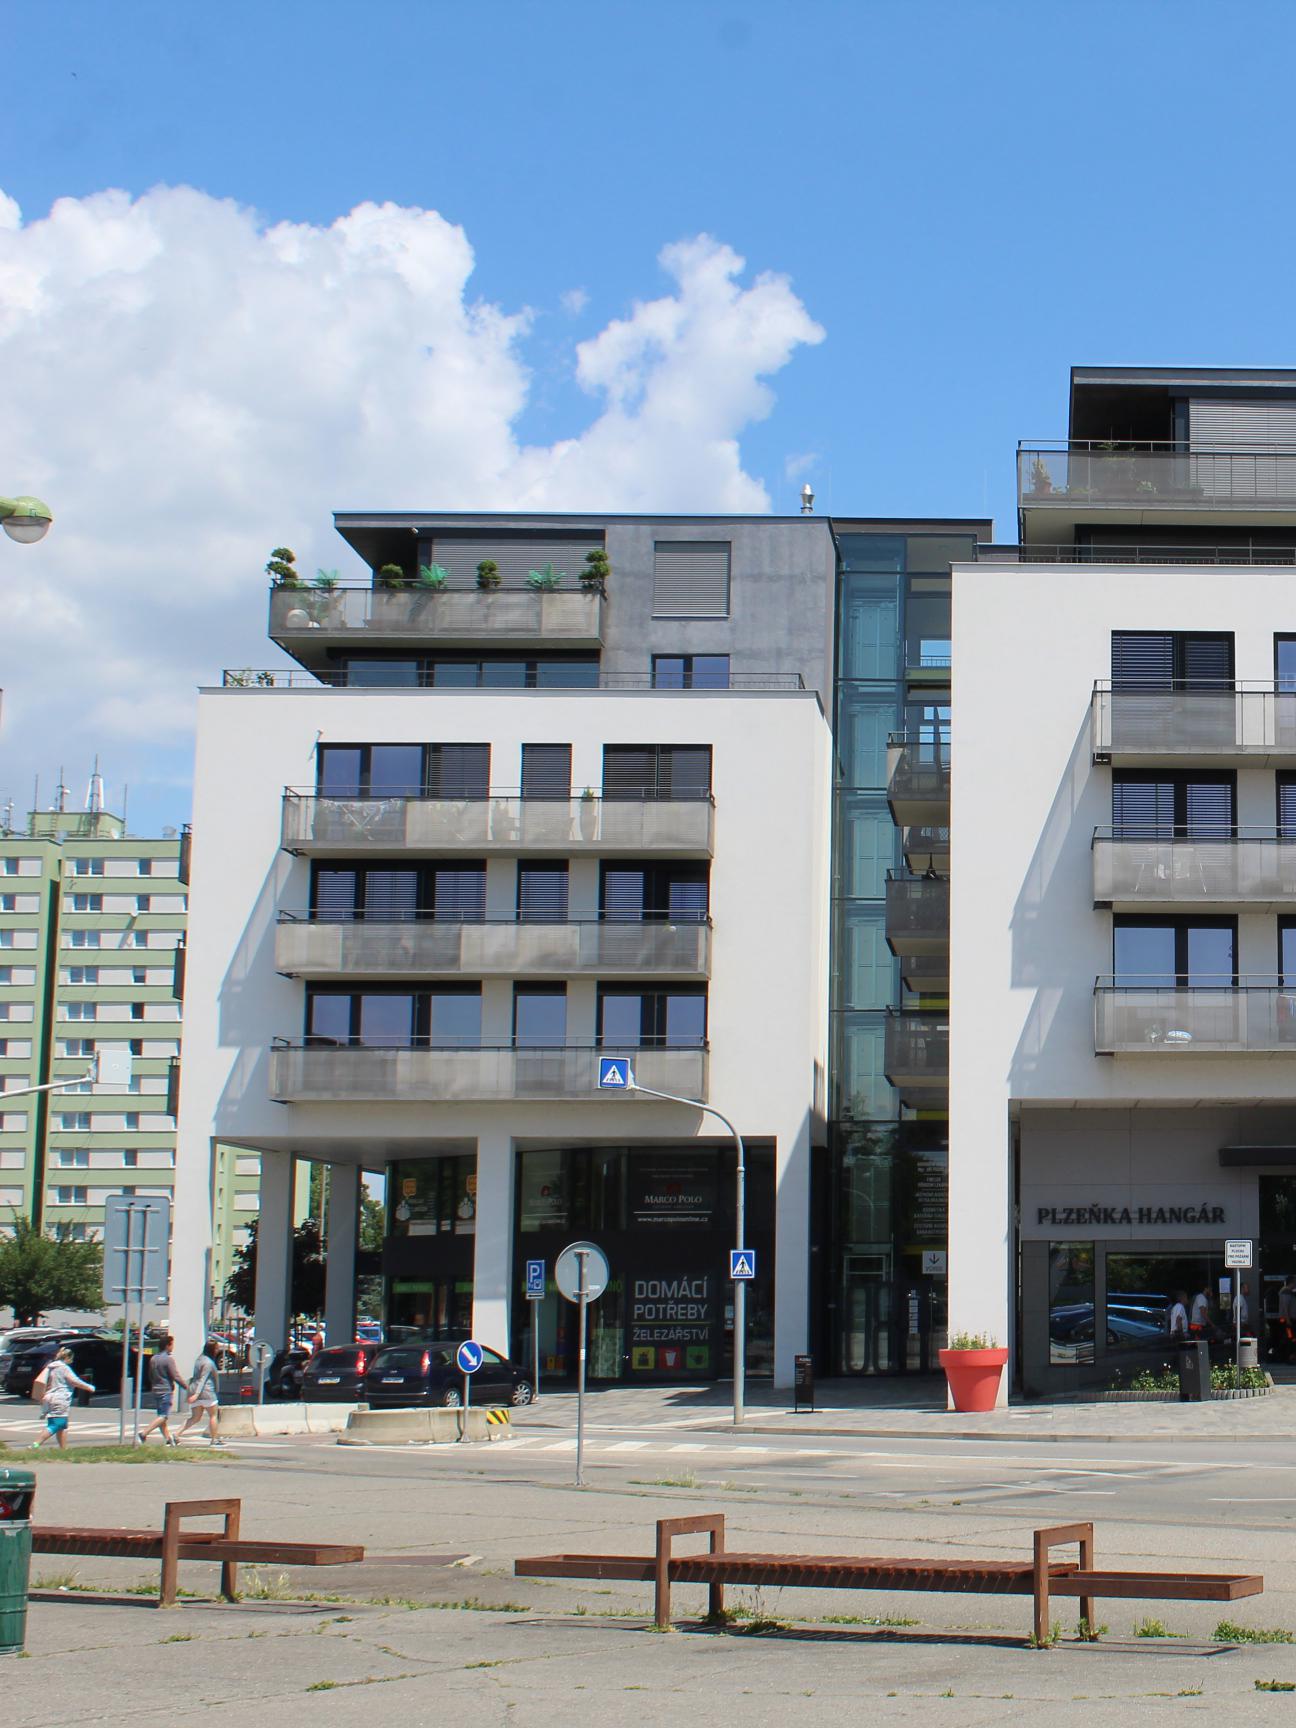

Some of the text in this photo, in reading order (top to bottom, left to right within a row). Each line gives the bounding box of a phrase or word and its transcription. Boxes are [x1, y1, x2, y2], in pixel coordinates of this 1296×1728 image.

[644, 1195, 702, 1203] MARCO POLO
[1037, 1203, 1225, 1225] PLZEŇKA HANGÁR
[530, 1265, 540, 1282] P
[635, 1276, 708, 1298] DOMÁCÍ
[634, 1300, 708, 1319] POTŘEBY
[633, 1327, 709, 1341] ŽELEZÁŘSTVÍ
